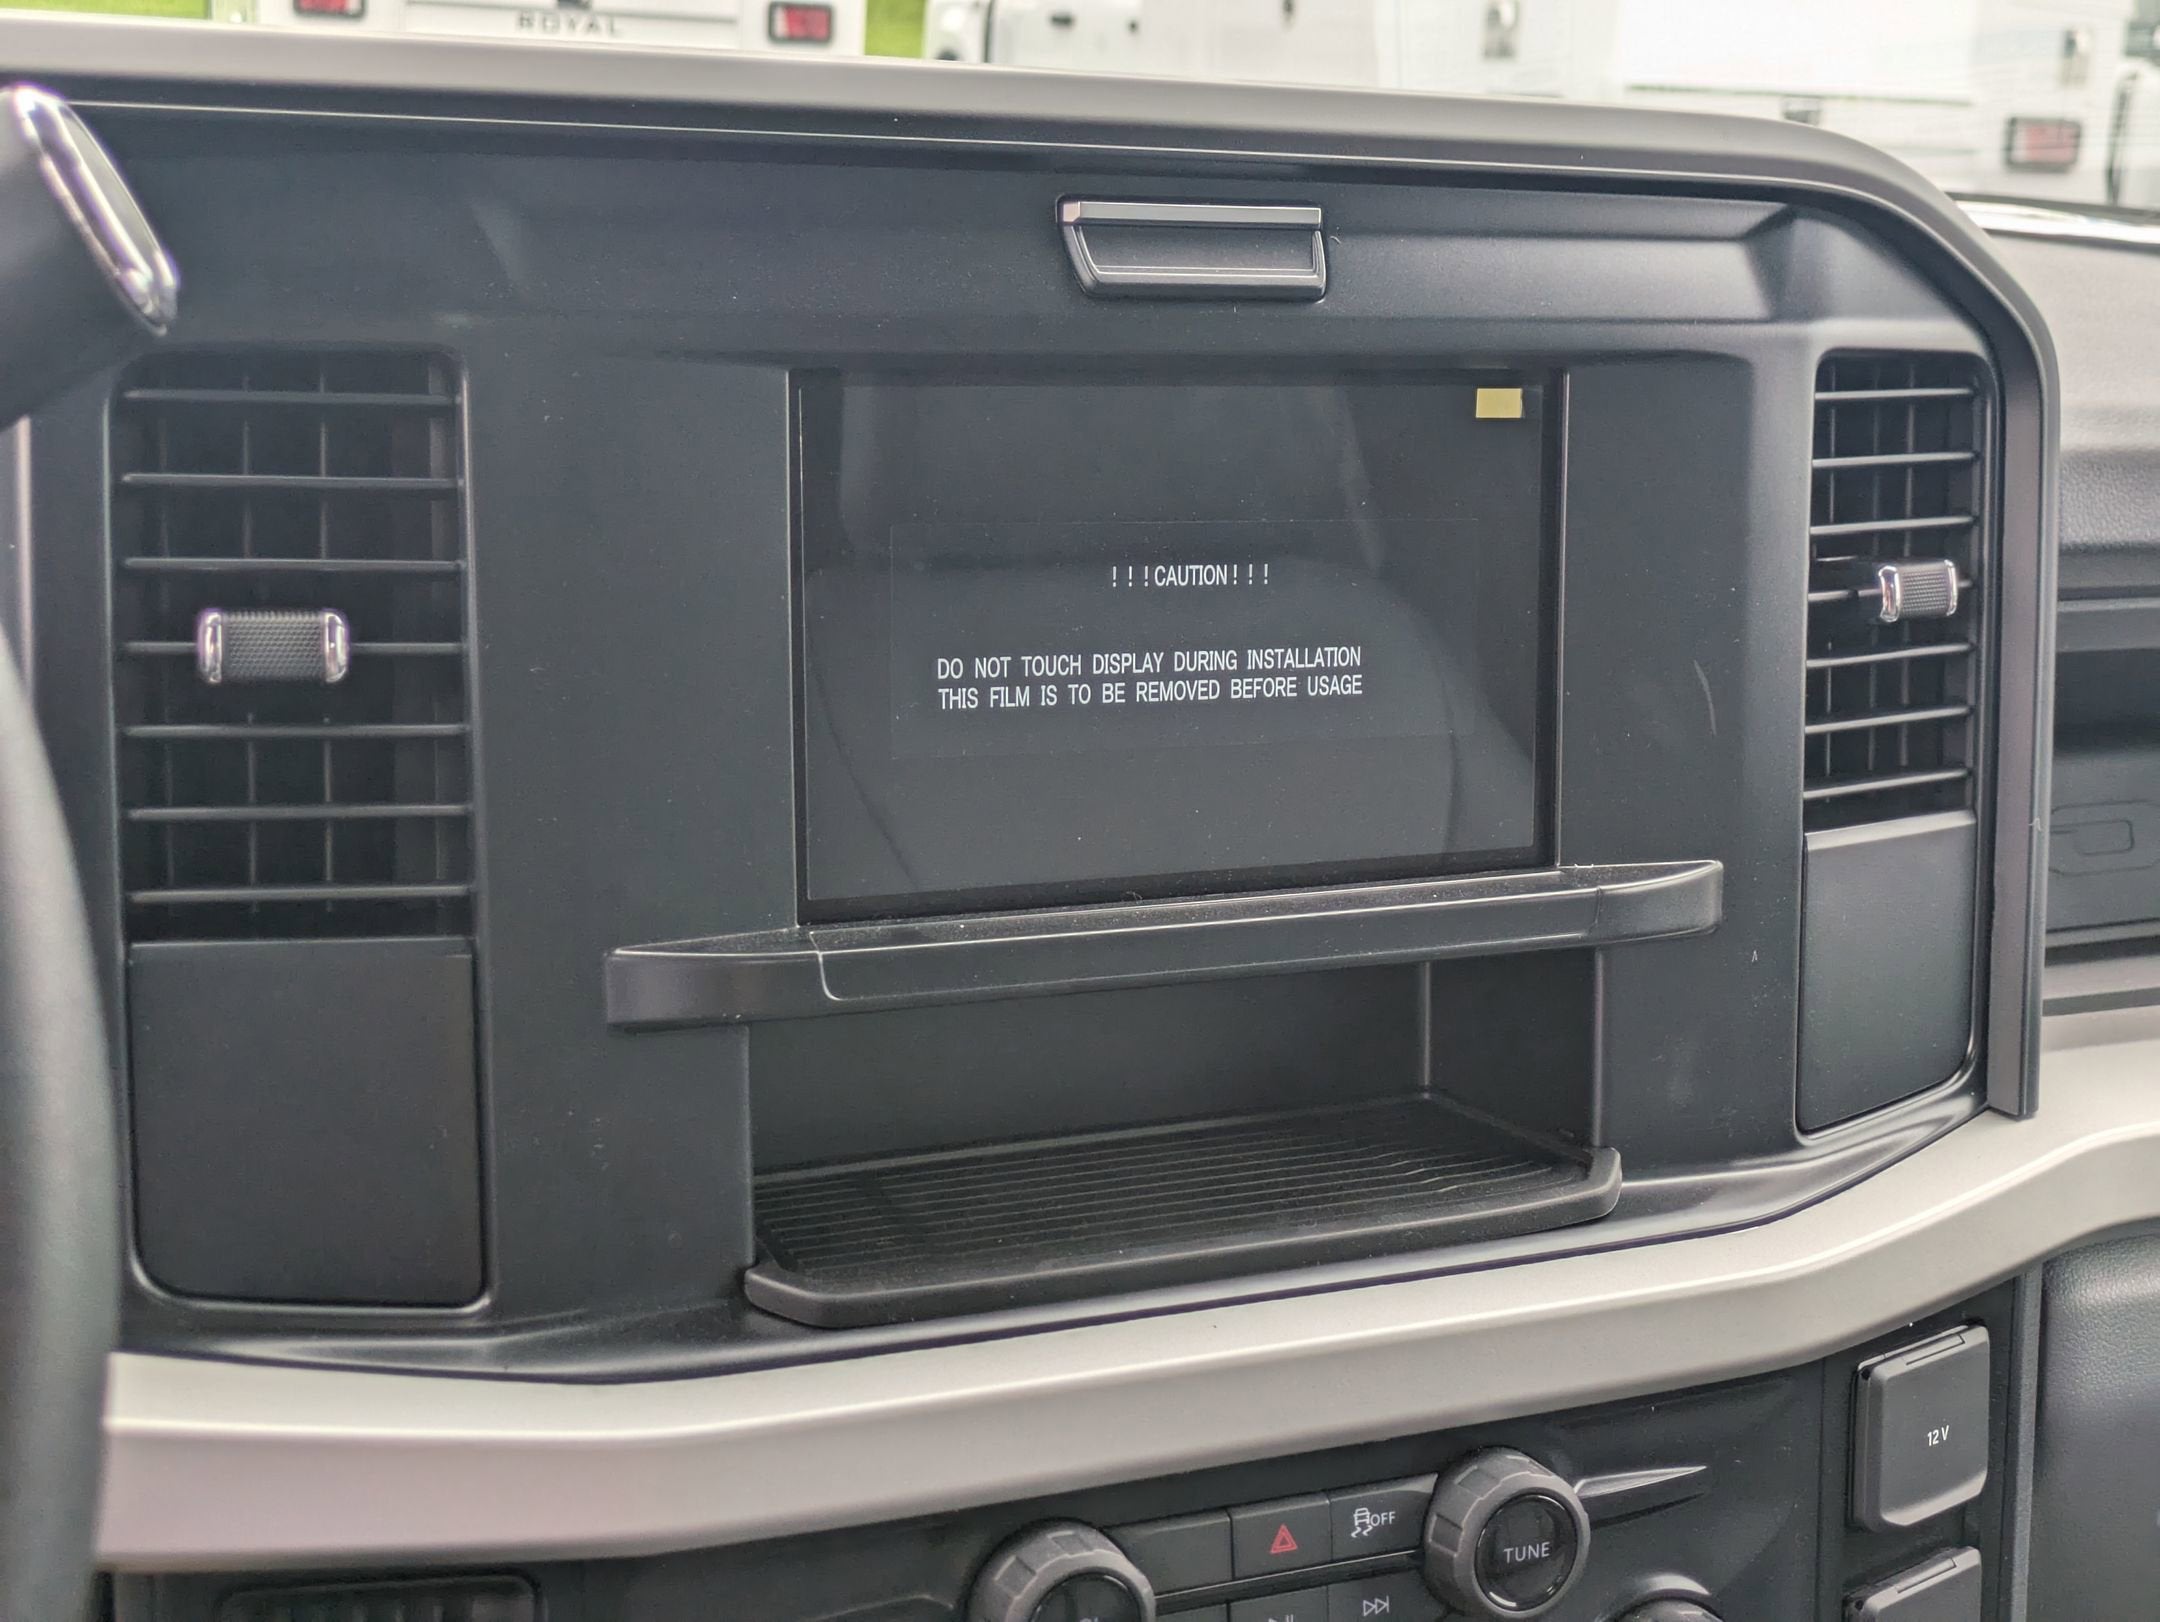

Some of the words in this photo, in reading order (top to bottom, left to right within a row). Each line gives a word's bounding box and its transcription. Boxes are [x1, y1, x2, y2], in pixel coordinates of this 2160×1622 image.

[937, 657, 964, 679] DO
[975, 656, 1012, 678] NOT
[1021, 654, 1082, 676] TOUCH
[1092, 652, 1164, 674] DISPLAY
[1174, 649, 1238, 672] DURING
[1247, 646, 1362, 670] INSTALLATION
[938, 687, 979, 710] THIS
[990, 686, 1030, 709] FILM
[1041, 685, 1058, 706] IS
[1068, 684, 1092, 704] TO
[1102, 682, 1126, 704] BE
[1136, 679, 1221, 702] REMOVED
[1231, 677, 1299, 699] BEFORE
[1307, 674, 1363, 697] USAGE
[1371, 1511, 1396, 1527] OFF
[1503, 1541, 1551, 1564] TUNE
